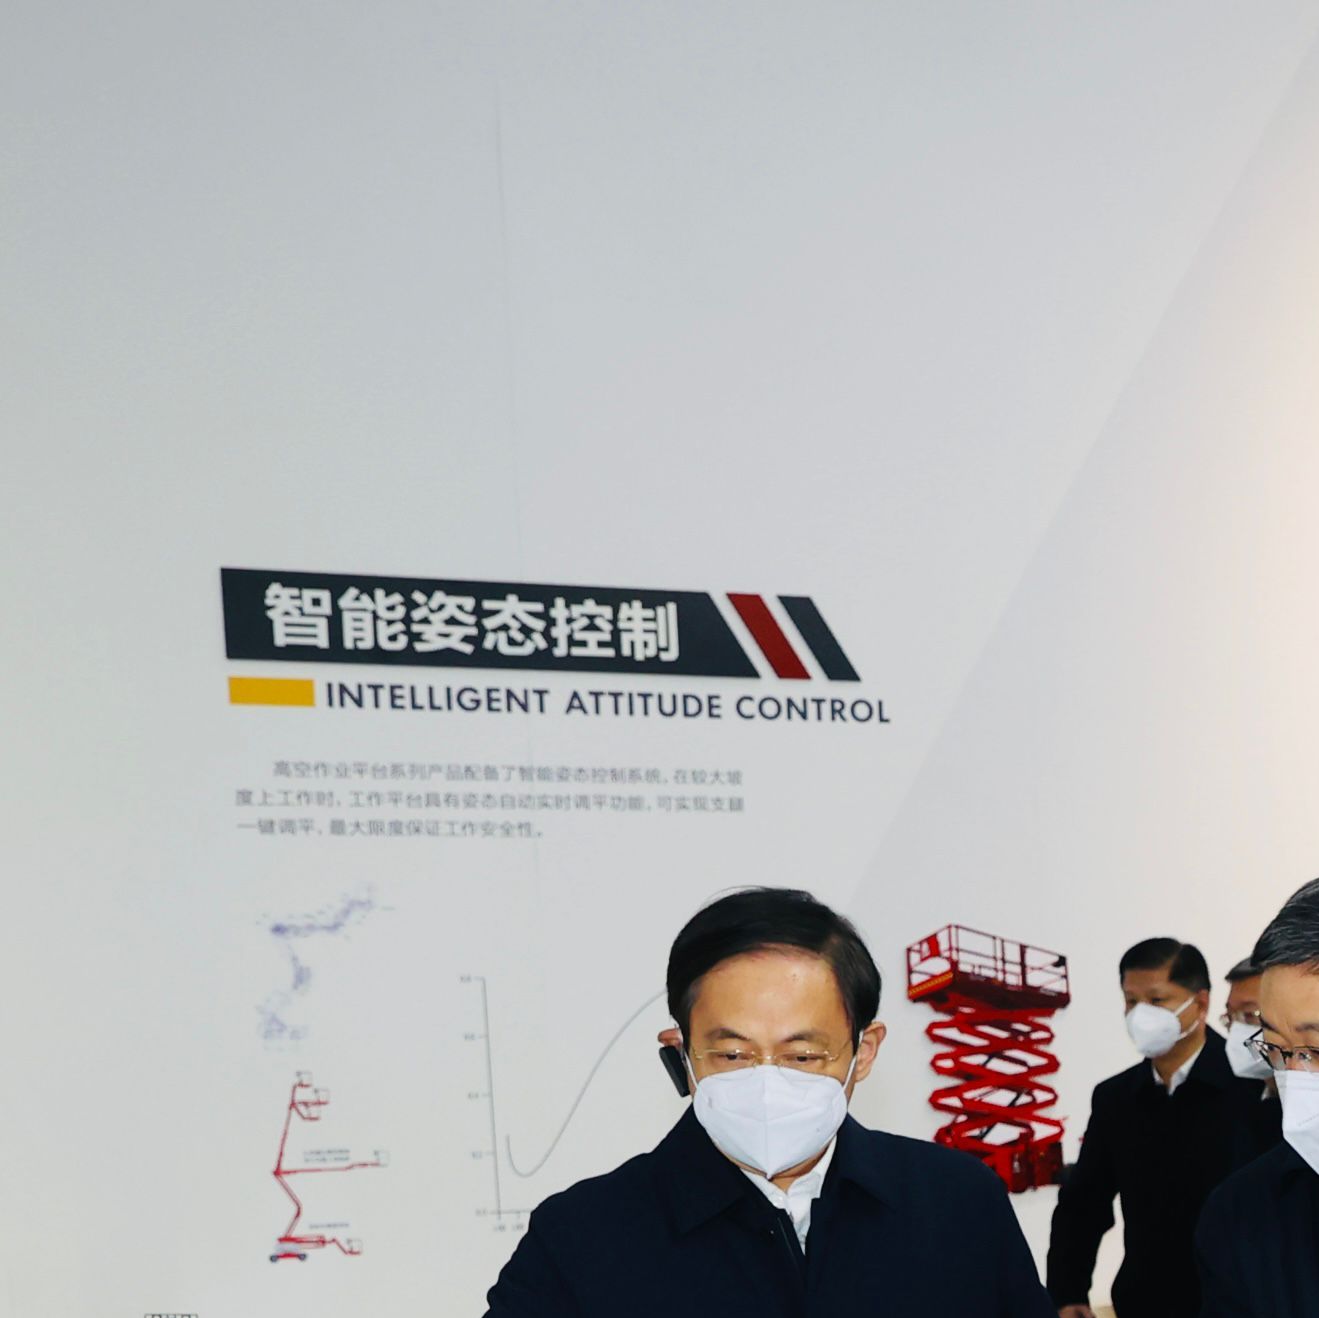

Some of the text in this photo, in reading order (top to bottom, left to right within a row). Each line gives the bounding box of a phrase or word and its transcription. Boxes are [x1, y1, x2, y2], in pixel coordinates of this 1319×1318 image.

[264, 582, 681, 662] 智能姿态控制
[325, 681, 890, 724] INTELLIGENT ATTITUDE CONTROL
